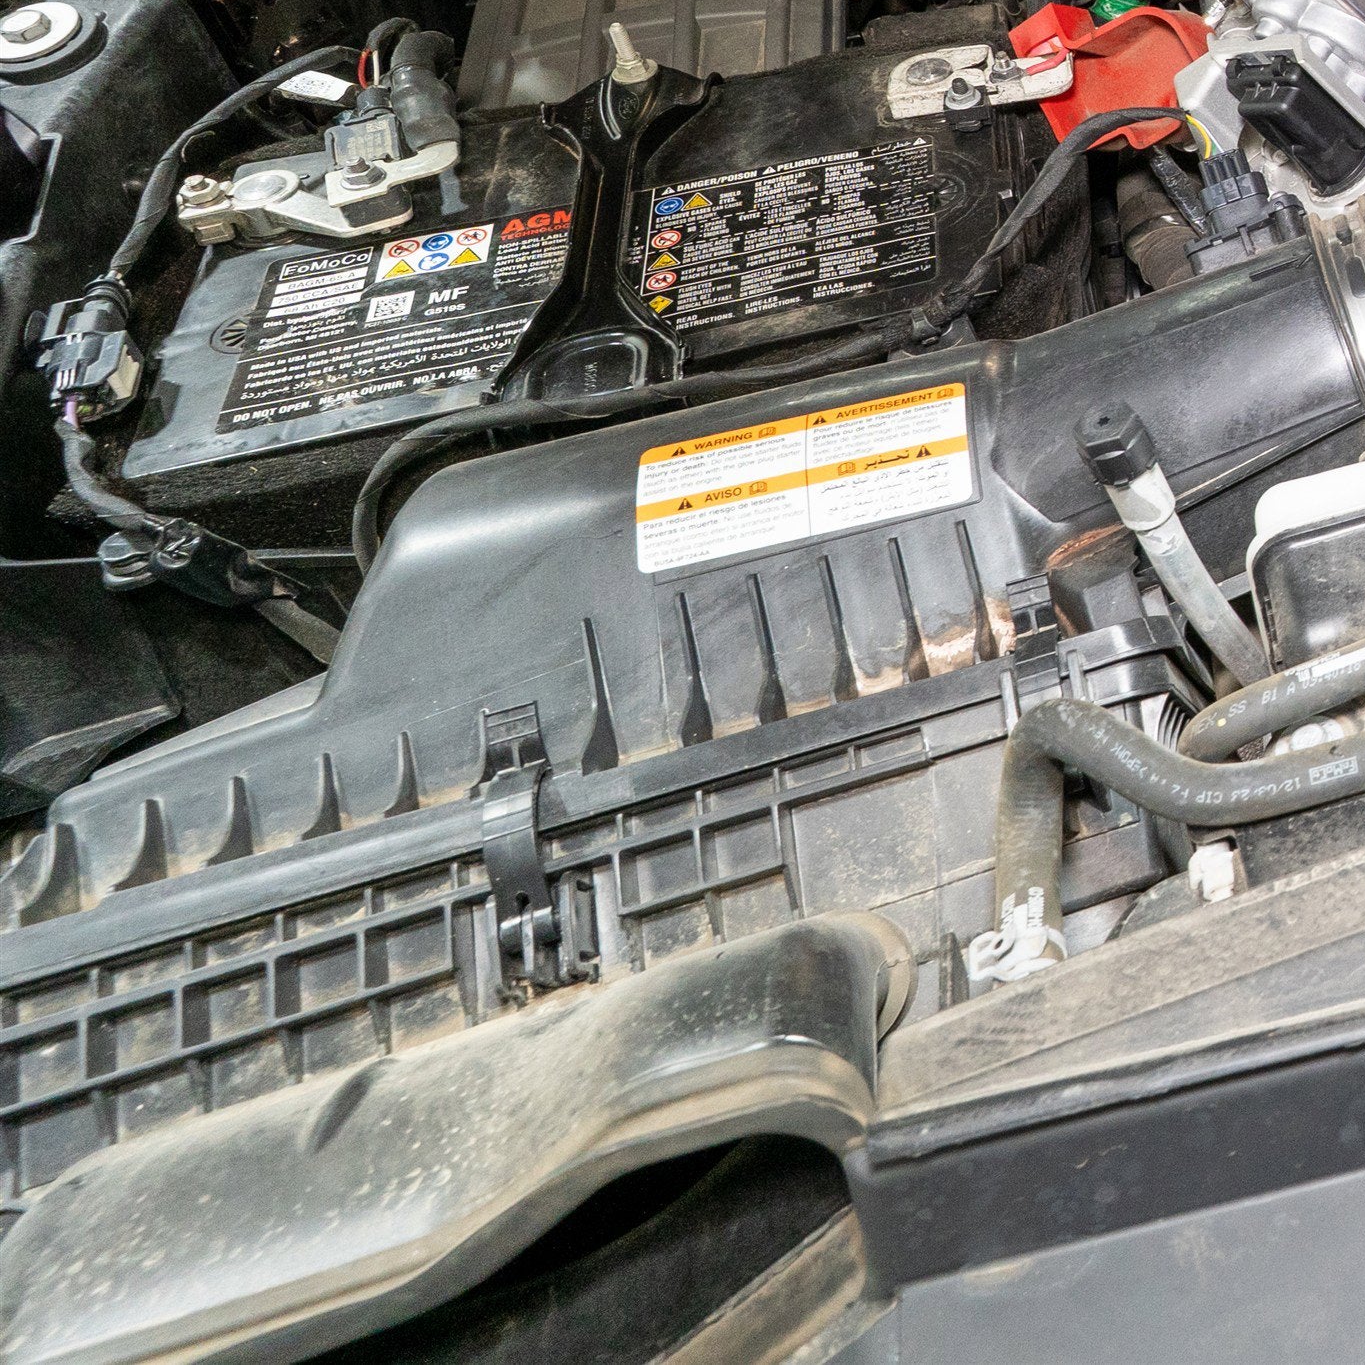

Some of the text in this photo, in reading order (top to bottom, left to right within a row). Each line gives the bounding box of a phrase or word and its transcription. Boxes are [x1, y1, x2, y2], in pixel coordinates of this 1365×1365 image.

[777, 151, 858, 175] PELIGRO/VENENO
[677, 171, 757, 191] DANGER/POISON
[501, 209, 572, 234] AGM
[656, 211, 692, 223] EXPLOSIVE
[501, 223, 570, 241] TECHNOLOG
[284, 253, 368, 275] FoMoCo
[302, 283, 355, 300] CCA/SAE
[428, 286, 469, 304] MF
[745, 296, 800, 314] INSTRUCTIONS.
[676, 314, 697, 324] READ
[676, 312, 734, 330] INSTRUCTIONS.
[360, 380, 406, 395] OUVRIR.
[233, 401, 311, 423] DO NOT OPEN.
[837, 392, 931, 418] AVERTISSEMENT
[694, 432, 752, 450] WARNING
[657, 459, 686, 468] reduce
[718, 444, 752, 456] possible
[755, 437, 785, 447] serious
[705, 487, 742, 502] AVISO
[643, 522, 663, 530] Para
[666, 514, 696, 524] reducir
[751, 495, 786, 506] lesiones
